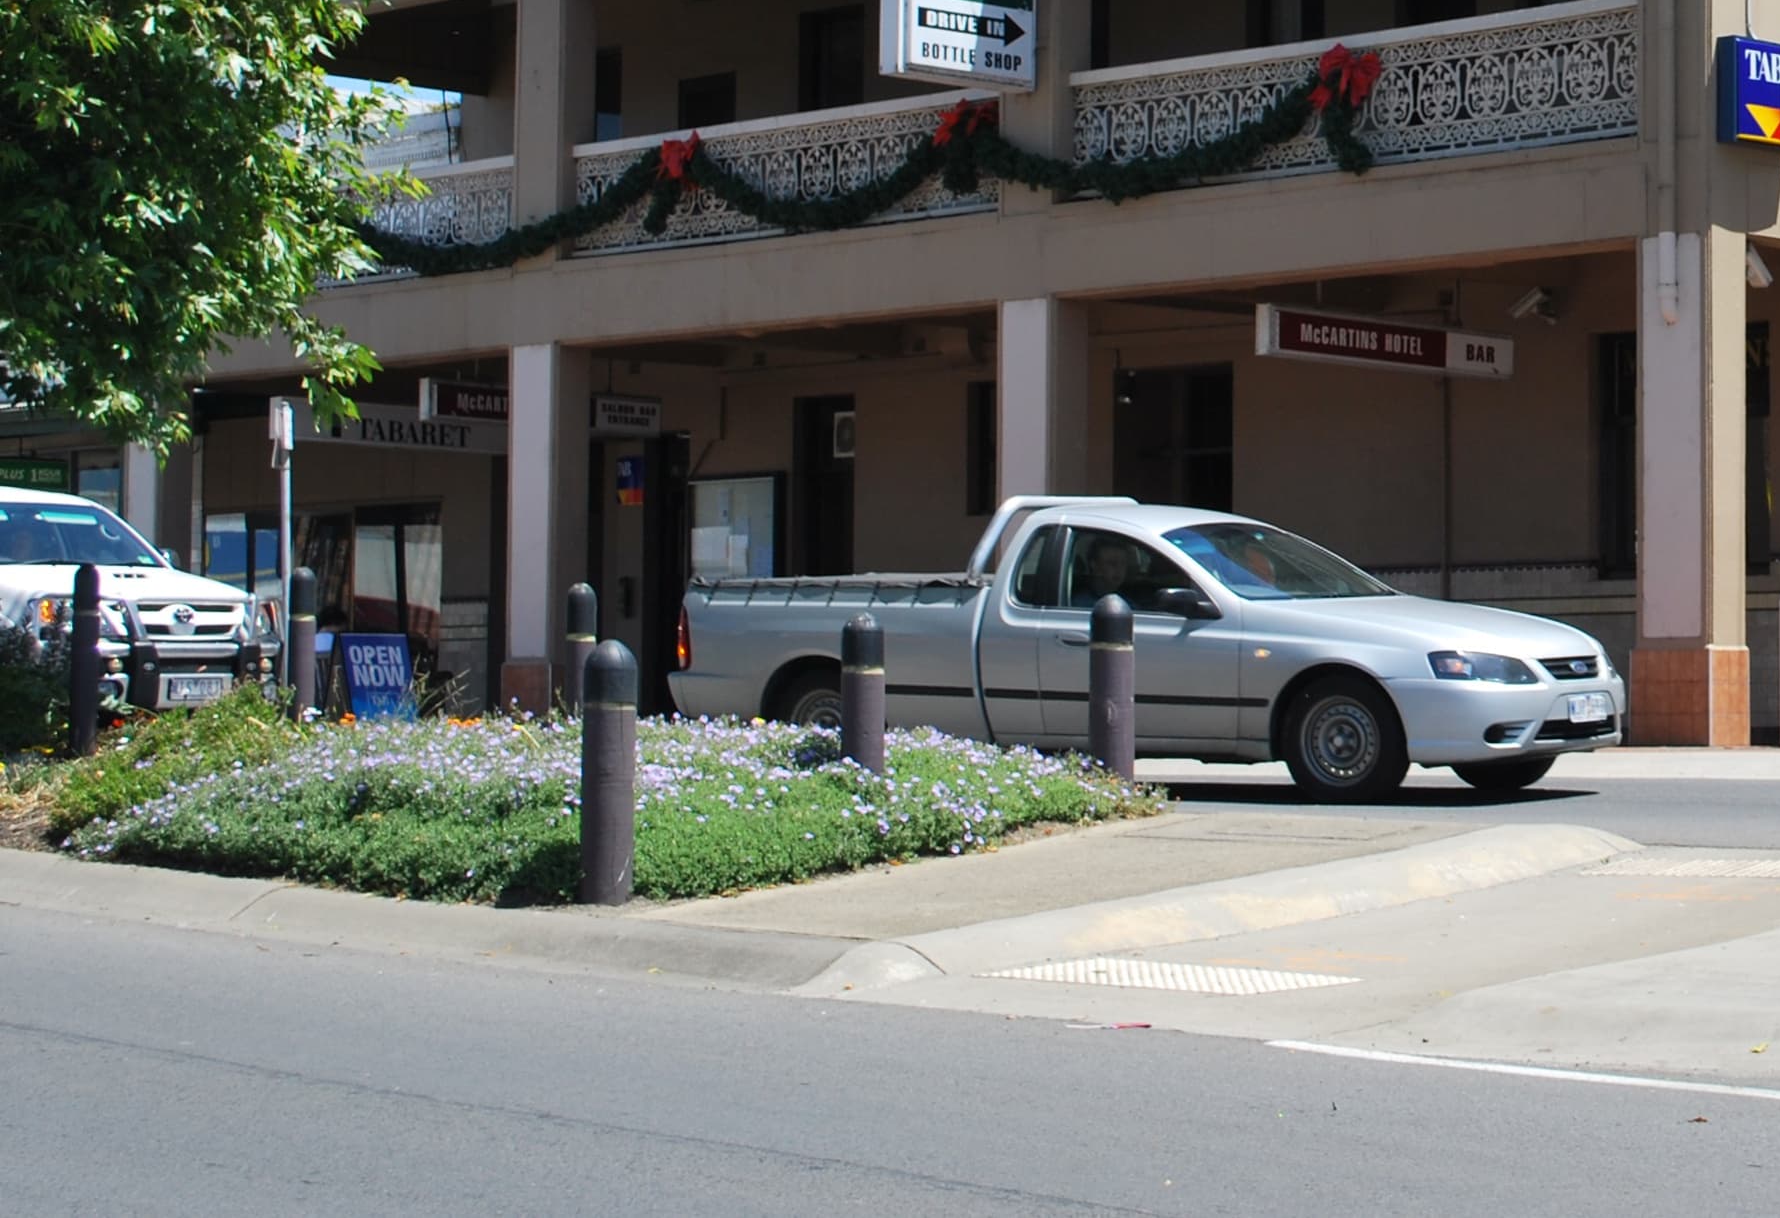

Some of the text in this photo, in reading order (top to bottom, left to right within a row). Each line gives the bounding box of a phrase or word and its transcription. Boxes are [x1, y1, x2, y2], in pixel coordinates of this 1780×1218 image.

[926, 10, 1005, 36] DRIVE IN
[922, 41, 1022, 71] BOTTLE SHOP
[1299, 322, 1424, 356] McCARTINS HOTEL
[1465, 343, 1496, 364] BAR
[360, 417, 472, 448] TABARET
[348, 645, 403, 665] OPEN
[352, 664, 405, 687] NOW
